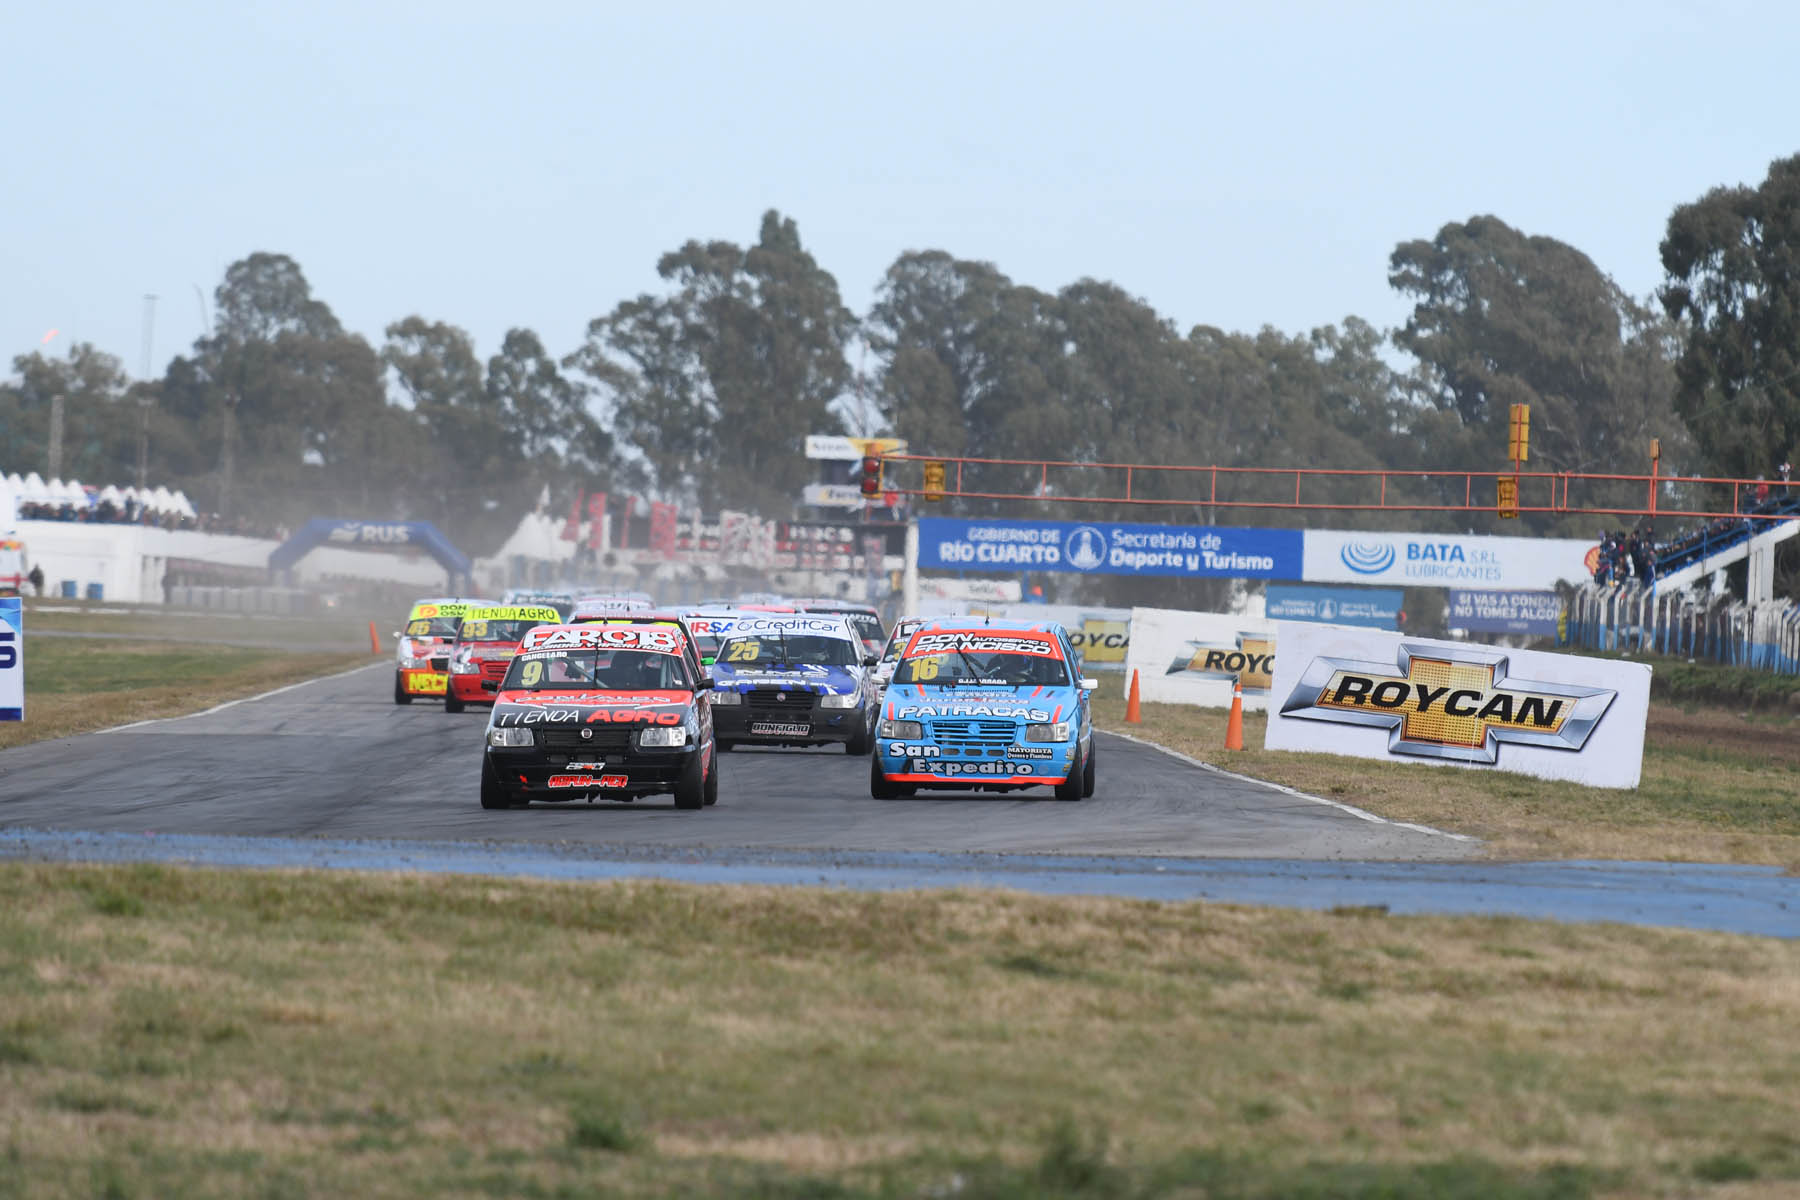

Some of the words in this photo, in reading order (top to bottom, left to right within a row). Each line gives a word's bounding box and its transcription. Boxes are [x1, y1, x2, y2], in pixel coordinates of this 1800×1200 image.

[362, 525, 410, 543] RUS
[967, 527, 1039, 544] GOBIERNO
[1040, 529, 1061, 545] DE
[1111, 529, 1197, 549] Secretaría
[1200, 533, 1222, 551] de
[939, 539, 975, 562] RÍO
[977, 543, 1061, 564] CUARTO
[1110, 549, 1184, 570] Deporte
[1186, 554, 1199, 571] y
[1202, 551, 1274, 570] Turismo
[1407, 542, 1465, 562] BATA
[1405, 564, 1502, 581] LUBRICANTES
[1459, 593, 1473, 605] SI
[1474, 593, 1497, 606] VAS
[1500, 594, 1509, 606] A
[471, 607, 515, 619] TIENDA
[518, 608, 555, 620] AGRO
[1455, 604, 1473, 617] NO
[1477, 605, 1518, 620] TOMES
[463, 622, 488, 638] 93
[753, 619, 840, 633] CreditCar
[911, 641, 1052, 655] FRANCISCO
[917, 632, 975, 646] DON
[728, 641, 761, 662] 25
[520, 660, 544, 687] 9
[909, 656, 939, 682] 16
[1332, 674, 1564, 728] ROYCAN
[500, 709, 580, 727] TIENDA
[586, 709, 681, 725] AGRO
[889, 742, 941, 758] San
[1007, 747, 1053, 755] MAYORISTA
[912, 759, 1034, 776] Expedito
